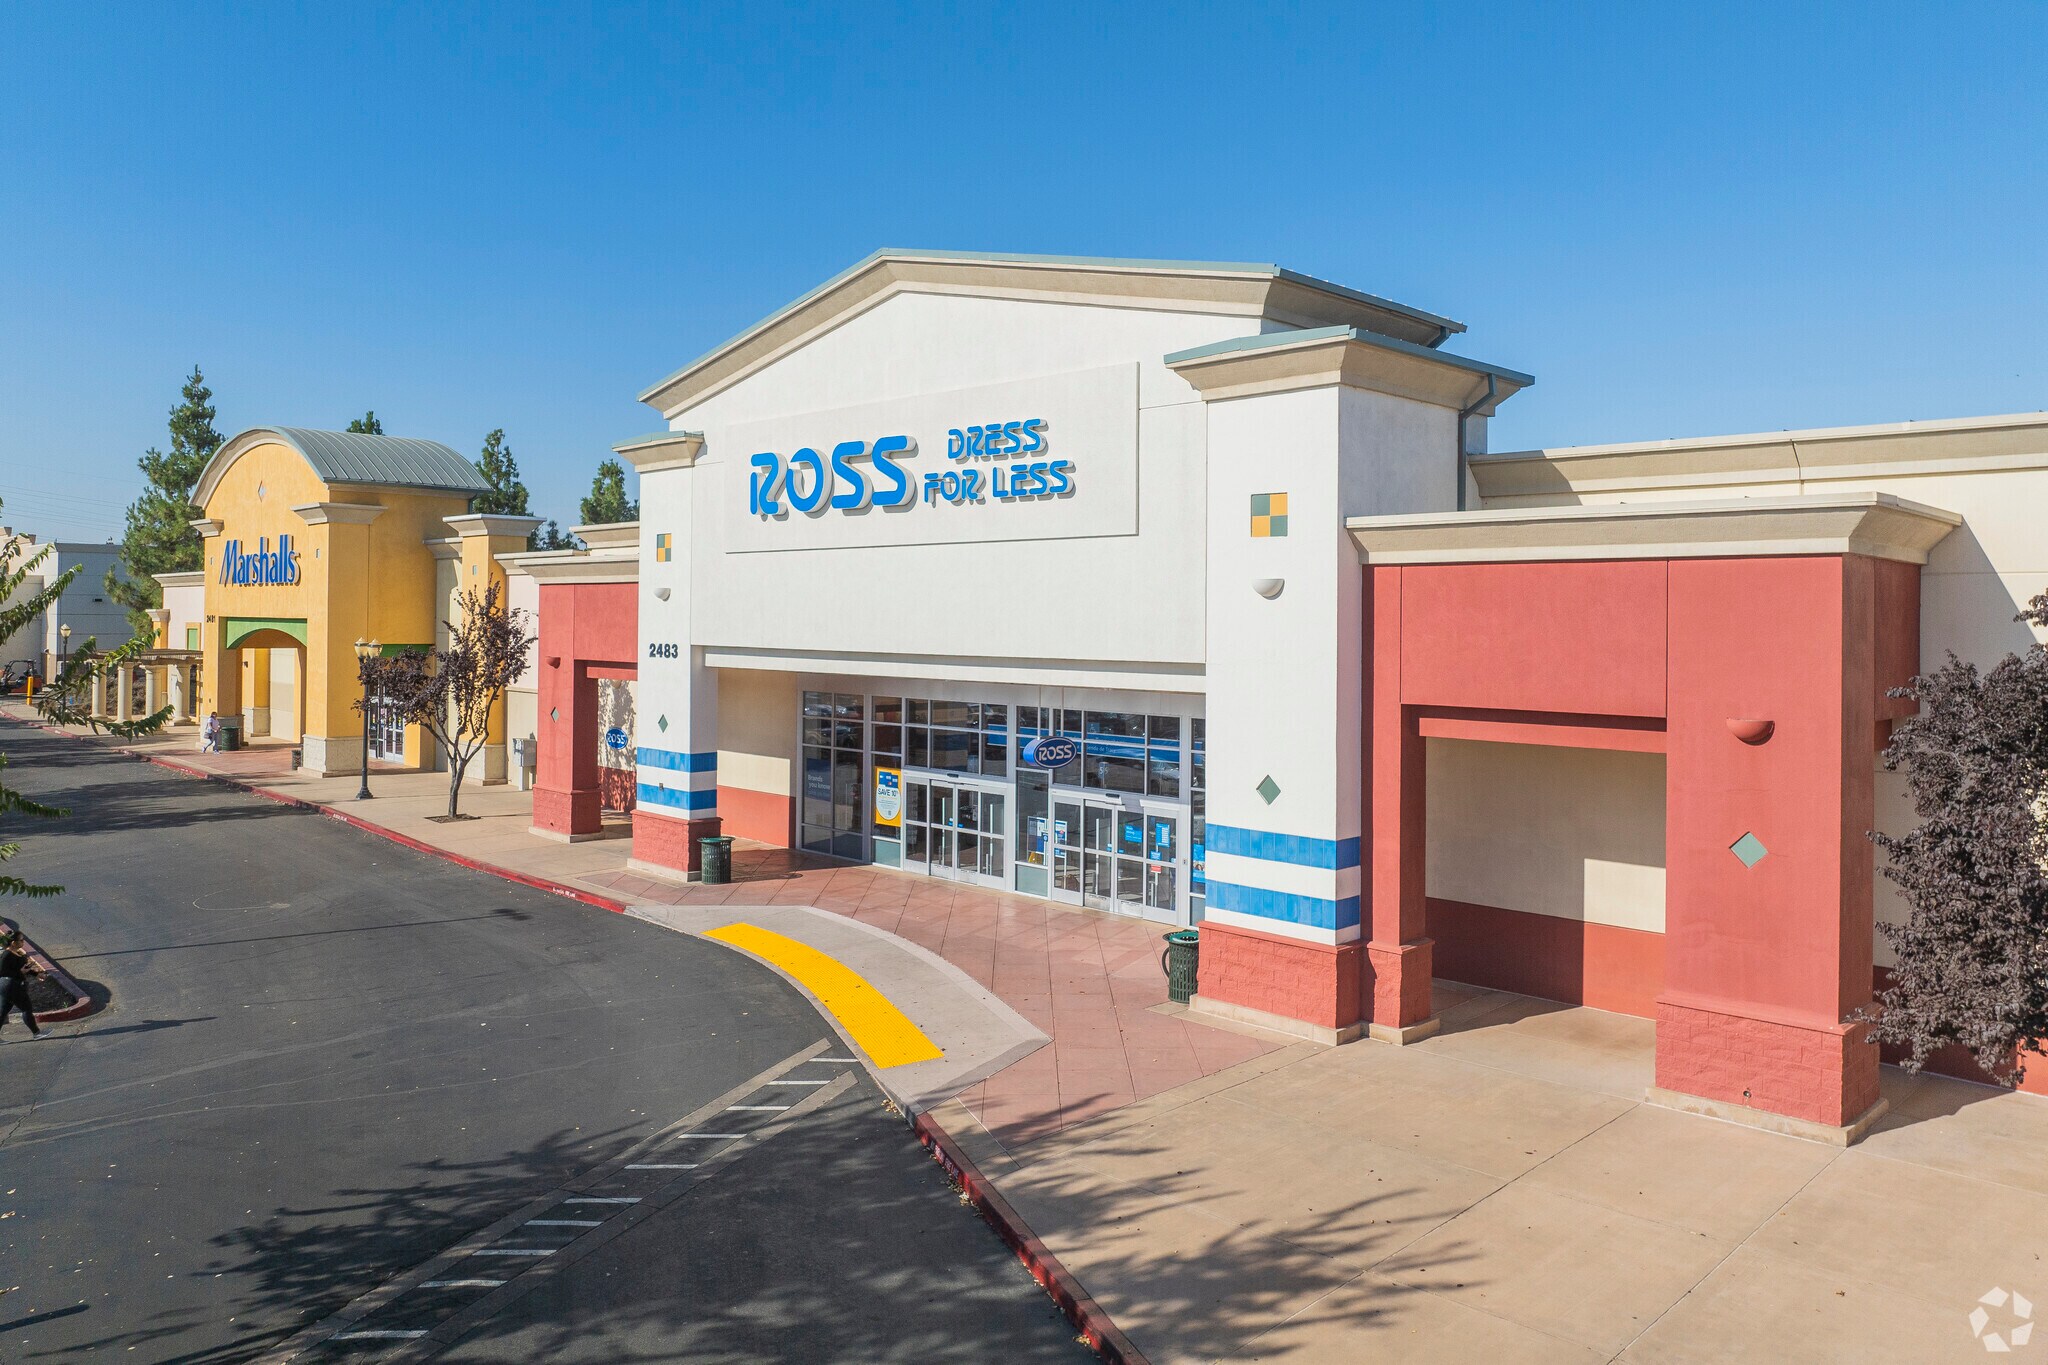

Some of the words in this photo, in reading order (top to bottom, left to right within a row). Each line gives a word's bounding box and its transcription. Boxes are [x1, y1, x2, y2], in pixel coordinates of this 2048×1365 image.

[947, 418, 1044, 460] DRESS
[750, 436, 912, 516] ROSS
[923, 469, 980, 503] FOR
[992, 460, 1070, 498] LESS
[219, 534, 298, 585] Marshalls
[649, 643, 679, 659] 2483
[607, 733, 626, 745] ROSS
[1038, 744, 1072, 761] ROSS
[878, 788, 890, 796] SAVE
